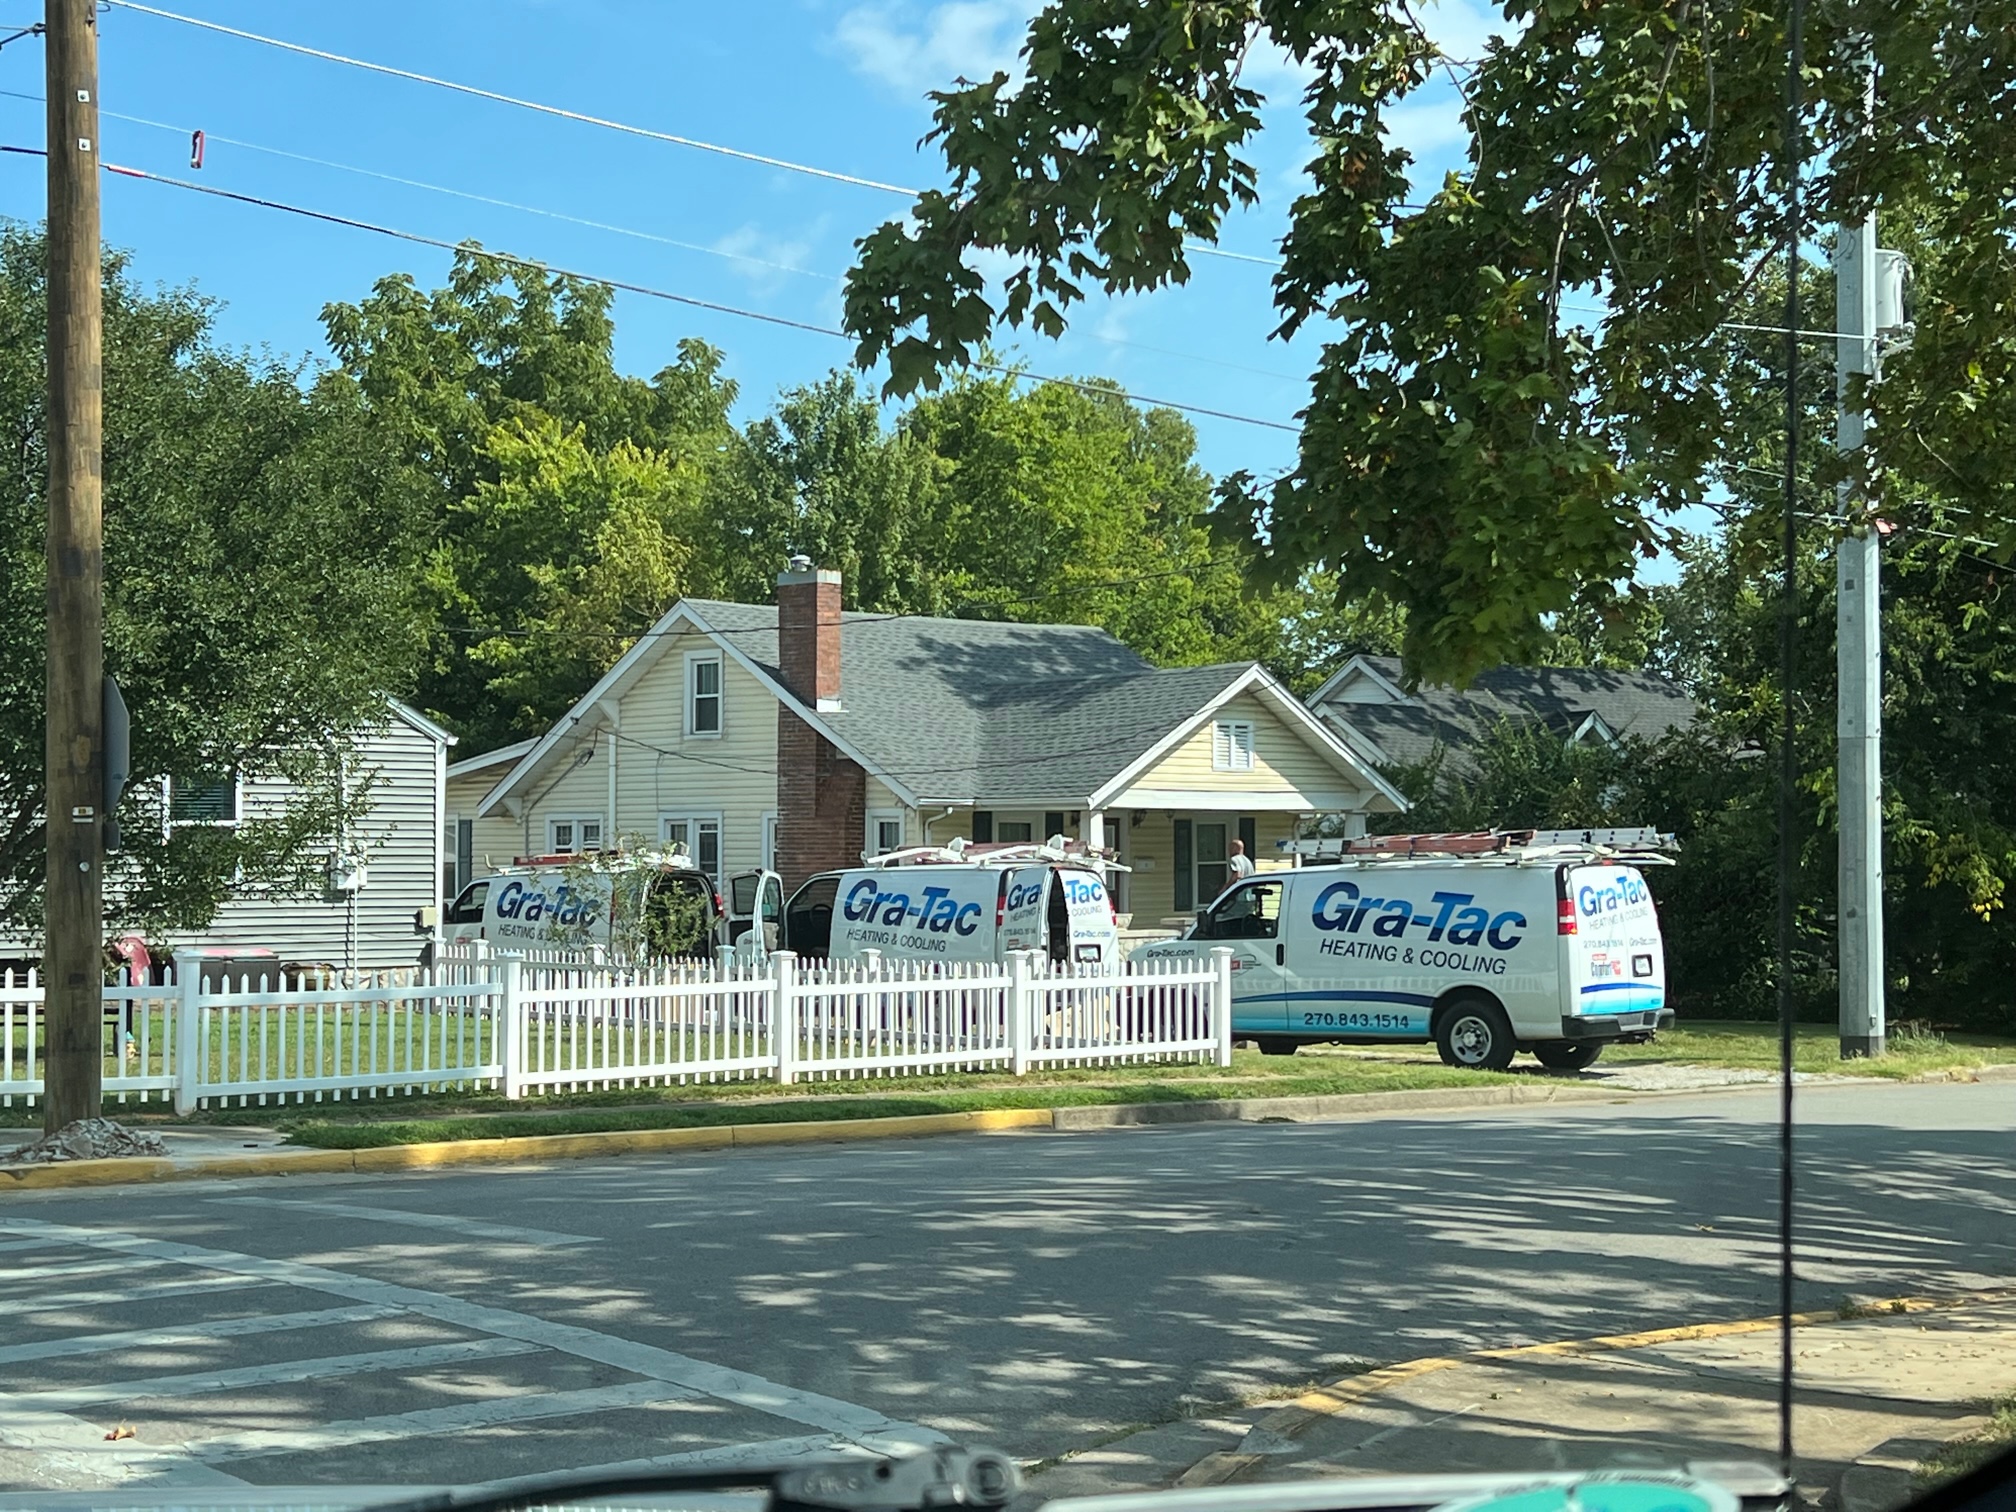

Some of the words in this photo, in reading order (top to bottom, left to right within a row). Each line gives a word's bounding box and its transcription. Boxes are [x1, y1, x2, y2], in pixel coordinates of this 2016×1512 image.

[844, 879, 981, 936] Gra-Tac
[1580, 876, 1647, 917] Gra-Tac
[498, 924, 535, 940] HEATING
[1312, 882, 1527, 950] Gra-Tac
[847, 928, 889, 944] HEATING
[891, 933, 898, 945] &
[900, 934, 946, 952] COOLING
[1320, 938, 1398, 962] HEATING
[1402, 948, 1414, 964] &
[1420, 950, 1507, 975] COOLING
[1304, 1012, 1409, 1029] 270.843.1514
